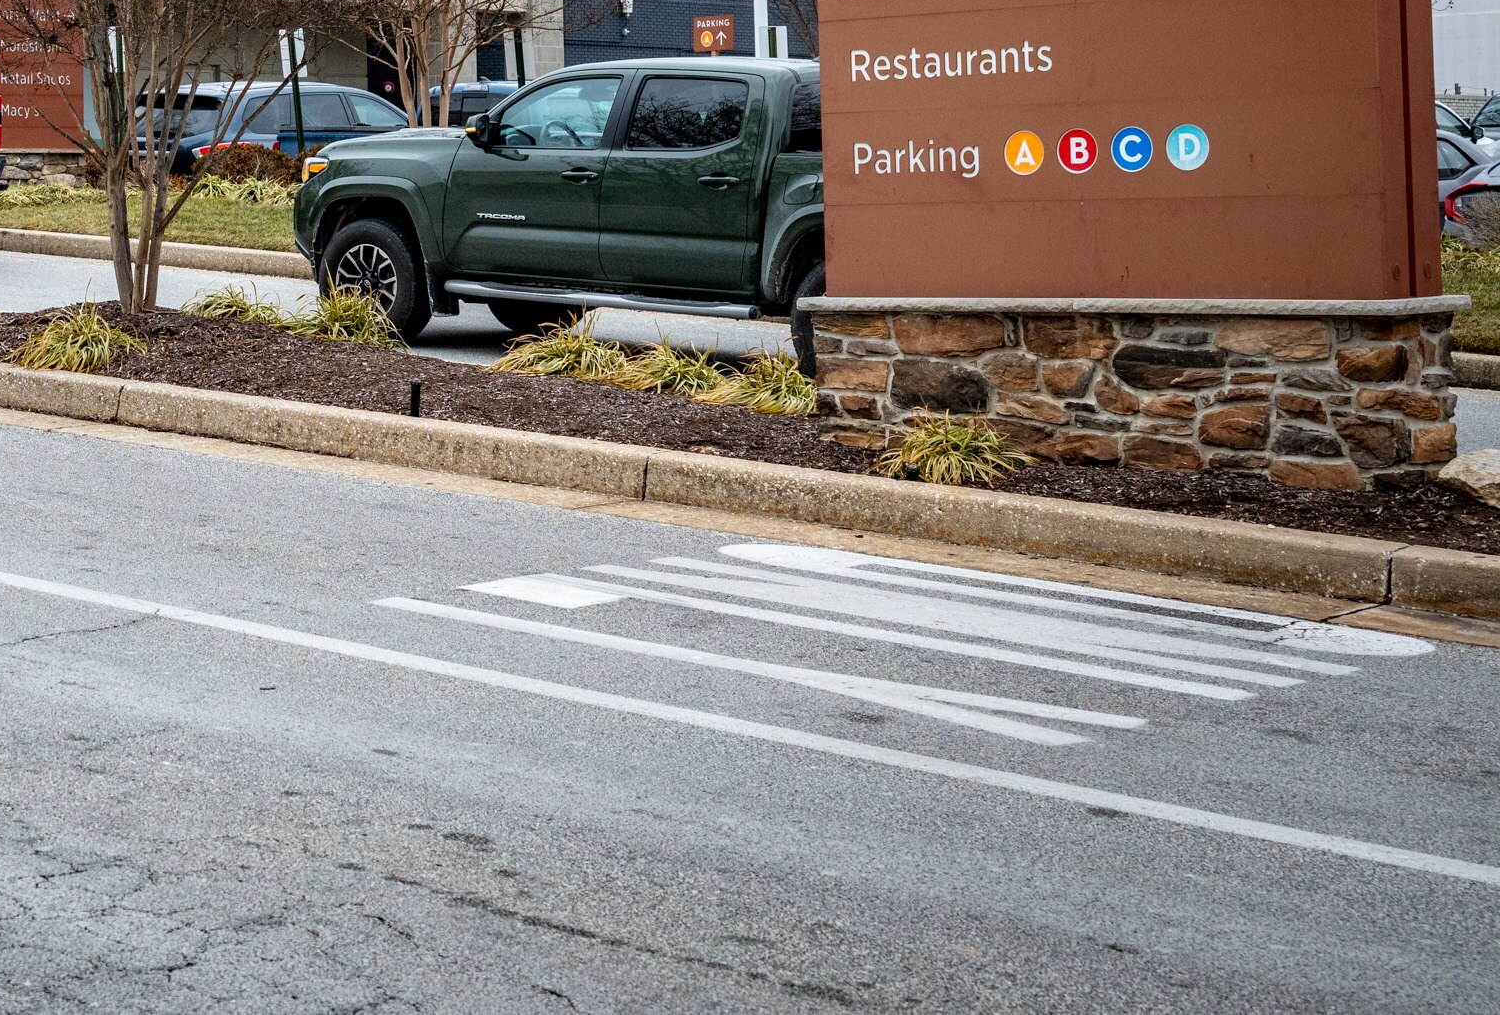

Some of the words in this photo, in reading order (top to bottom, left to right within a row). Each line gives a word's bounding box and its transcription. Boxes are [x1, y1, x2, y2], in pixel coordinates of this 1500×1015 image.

[697, 19, 730, 28] PARKING
[850, 39, 1053, 82] Restaurants
[852, 138, 980, 178] Parking
[1014, 140, 1036, 166] A
[1069, 136, 1090, 165] B
[1118, 133, 1143, 163] C
[1178, 131, 1201, 162] D
[476, 212, 526, 221] TACOMA
